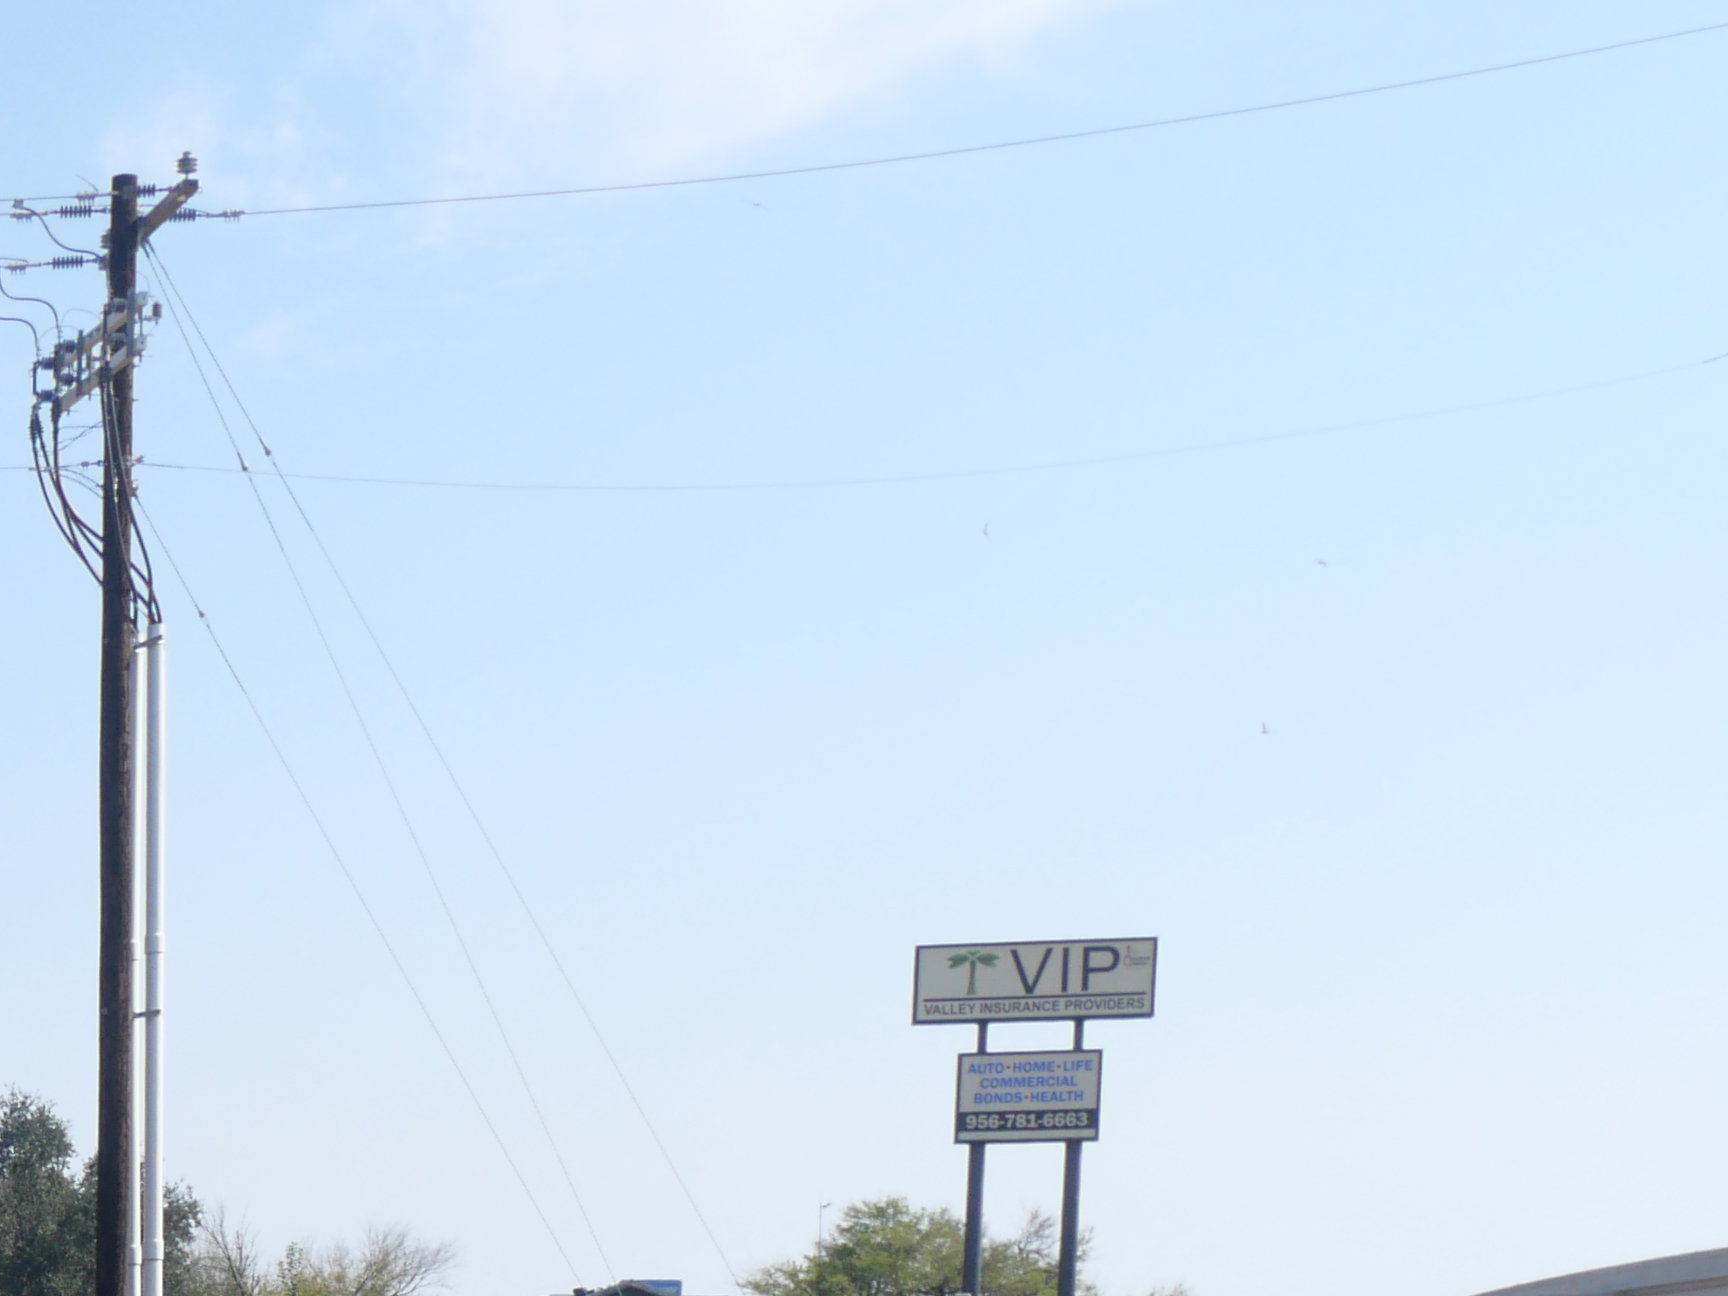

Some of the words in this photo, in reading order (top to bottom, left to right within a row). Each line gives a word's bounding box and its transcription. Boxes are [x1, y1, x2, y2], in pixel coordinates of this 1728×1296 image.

[1010, 946, 1121, 995] VIP
[923, 1003, 976, 1016] VALLEY
[979, 1000, 1060, 1014] INSURANCE
[1064, 998, 1145, 1011] PROVIDERS
[967, 1062, 1005, 1074] AUTO
[1012, 1061, 1056, 1073] HOME
[1063, 1060, 1093, 1072] LIFE
[979, 1076, 1078, 1089] COMMERCIAL
[973, 1092, 1022, 1105] BONDS
[1030, 1090, 1084, 1103] HEALTH
[965, 1112, 1089, 1129] 956-781-6663
